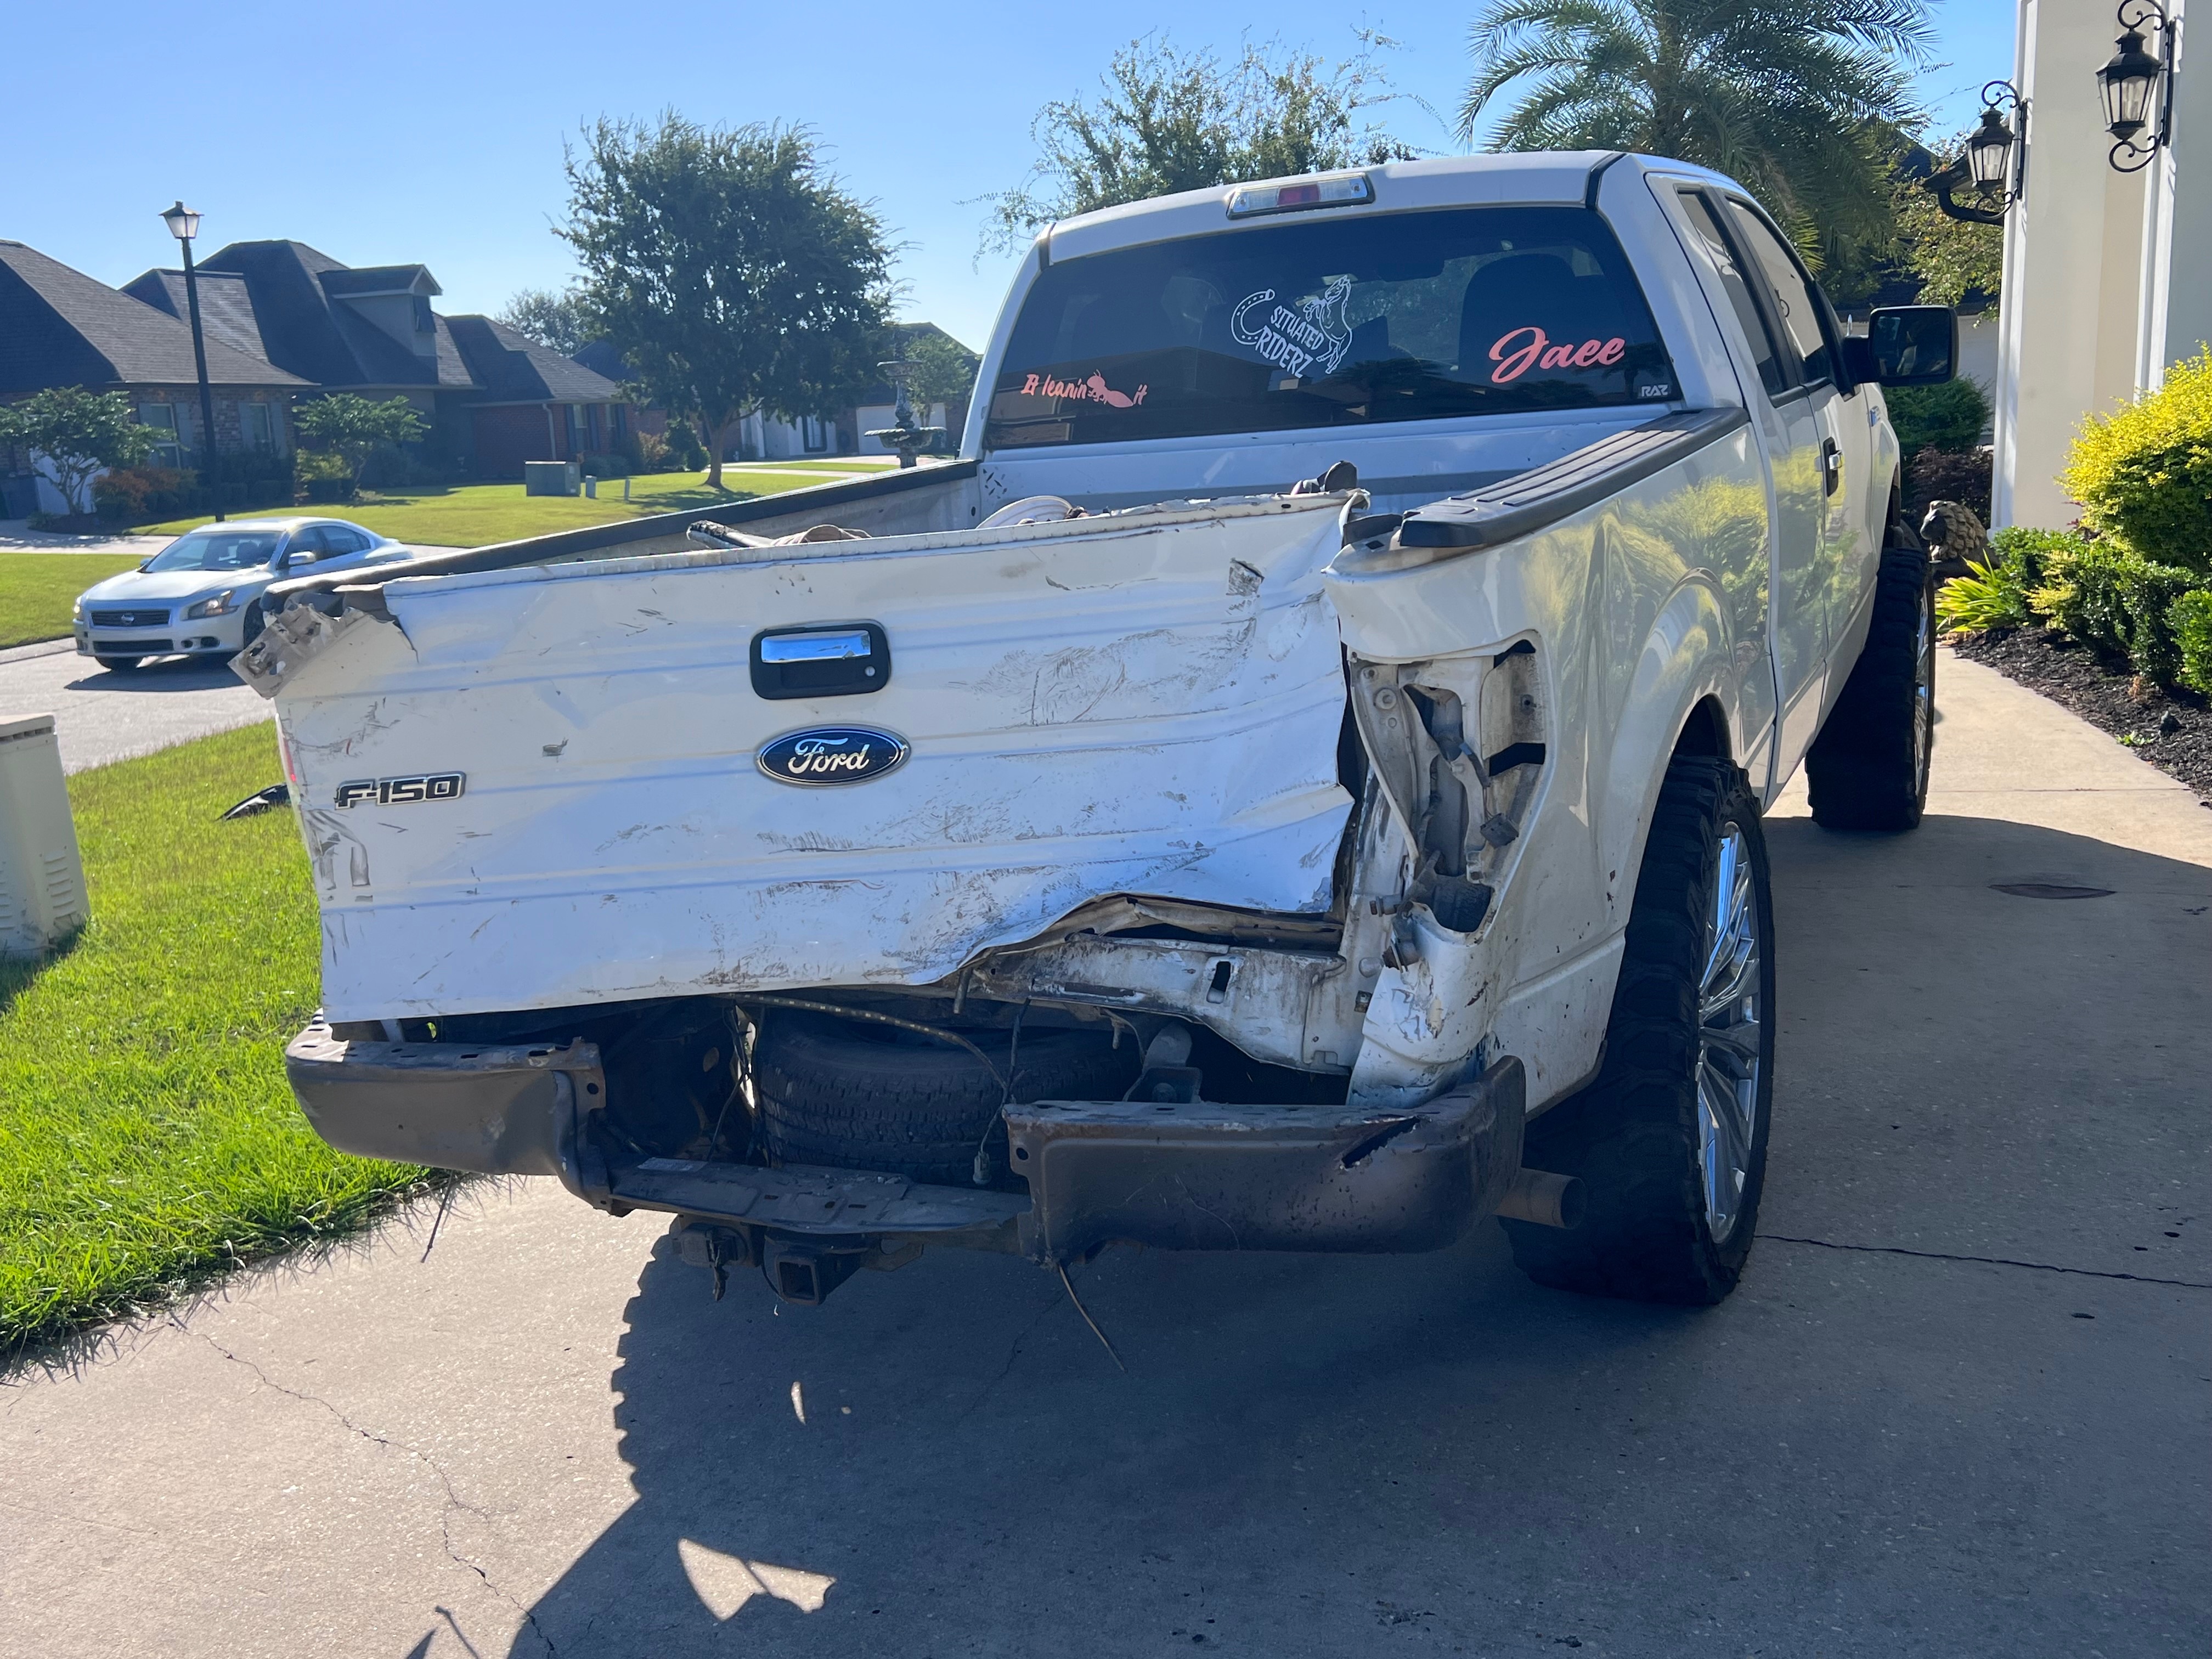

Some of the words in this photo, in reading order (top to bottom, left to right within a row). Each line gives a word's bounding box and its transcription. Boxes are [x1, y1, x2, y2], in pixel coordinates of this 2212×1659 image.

[1270, 305, 1325, 350] SITUATED
[1255, 325, 1314, 378] RIDERZ
[1042, 374, 1087, 399] leanin
[1133, 384, 1147, 405] it
[1641, 384, 1668, 397] RAZ
[788, 738, 870, 774] Ford
[335, 771, 466, 810] F-150
